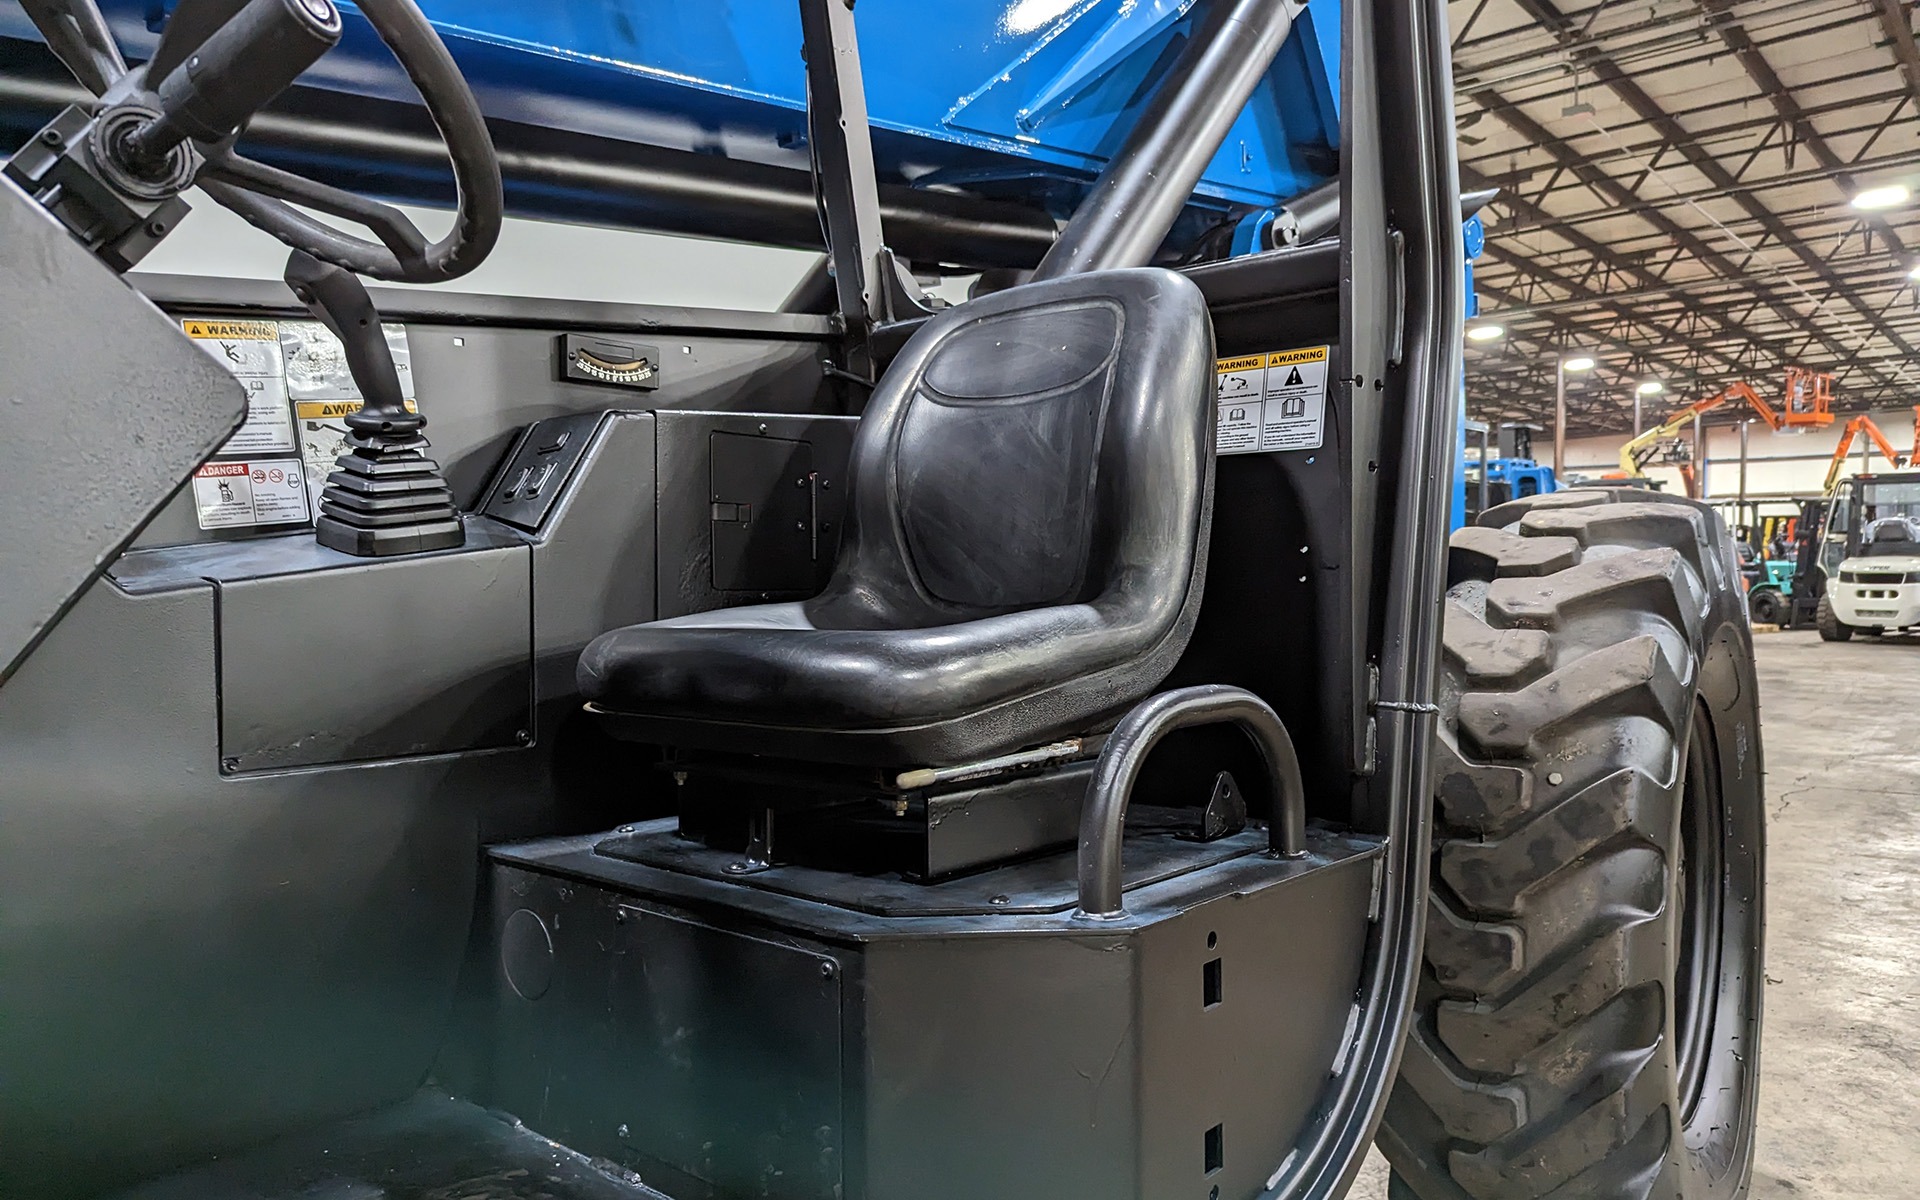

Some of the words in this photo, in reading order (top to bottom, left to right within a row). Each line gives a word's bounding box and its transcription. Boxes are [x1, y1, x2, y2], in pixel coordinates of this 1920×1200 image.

[207, 325, 271, 336] WARNING
[1278, 350, 1323, 362] WARNING
[1217, 359, 1258, 370] WARNING
[208, 465, 245, 476] DANGER
